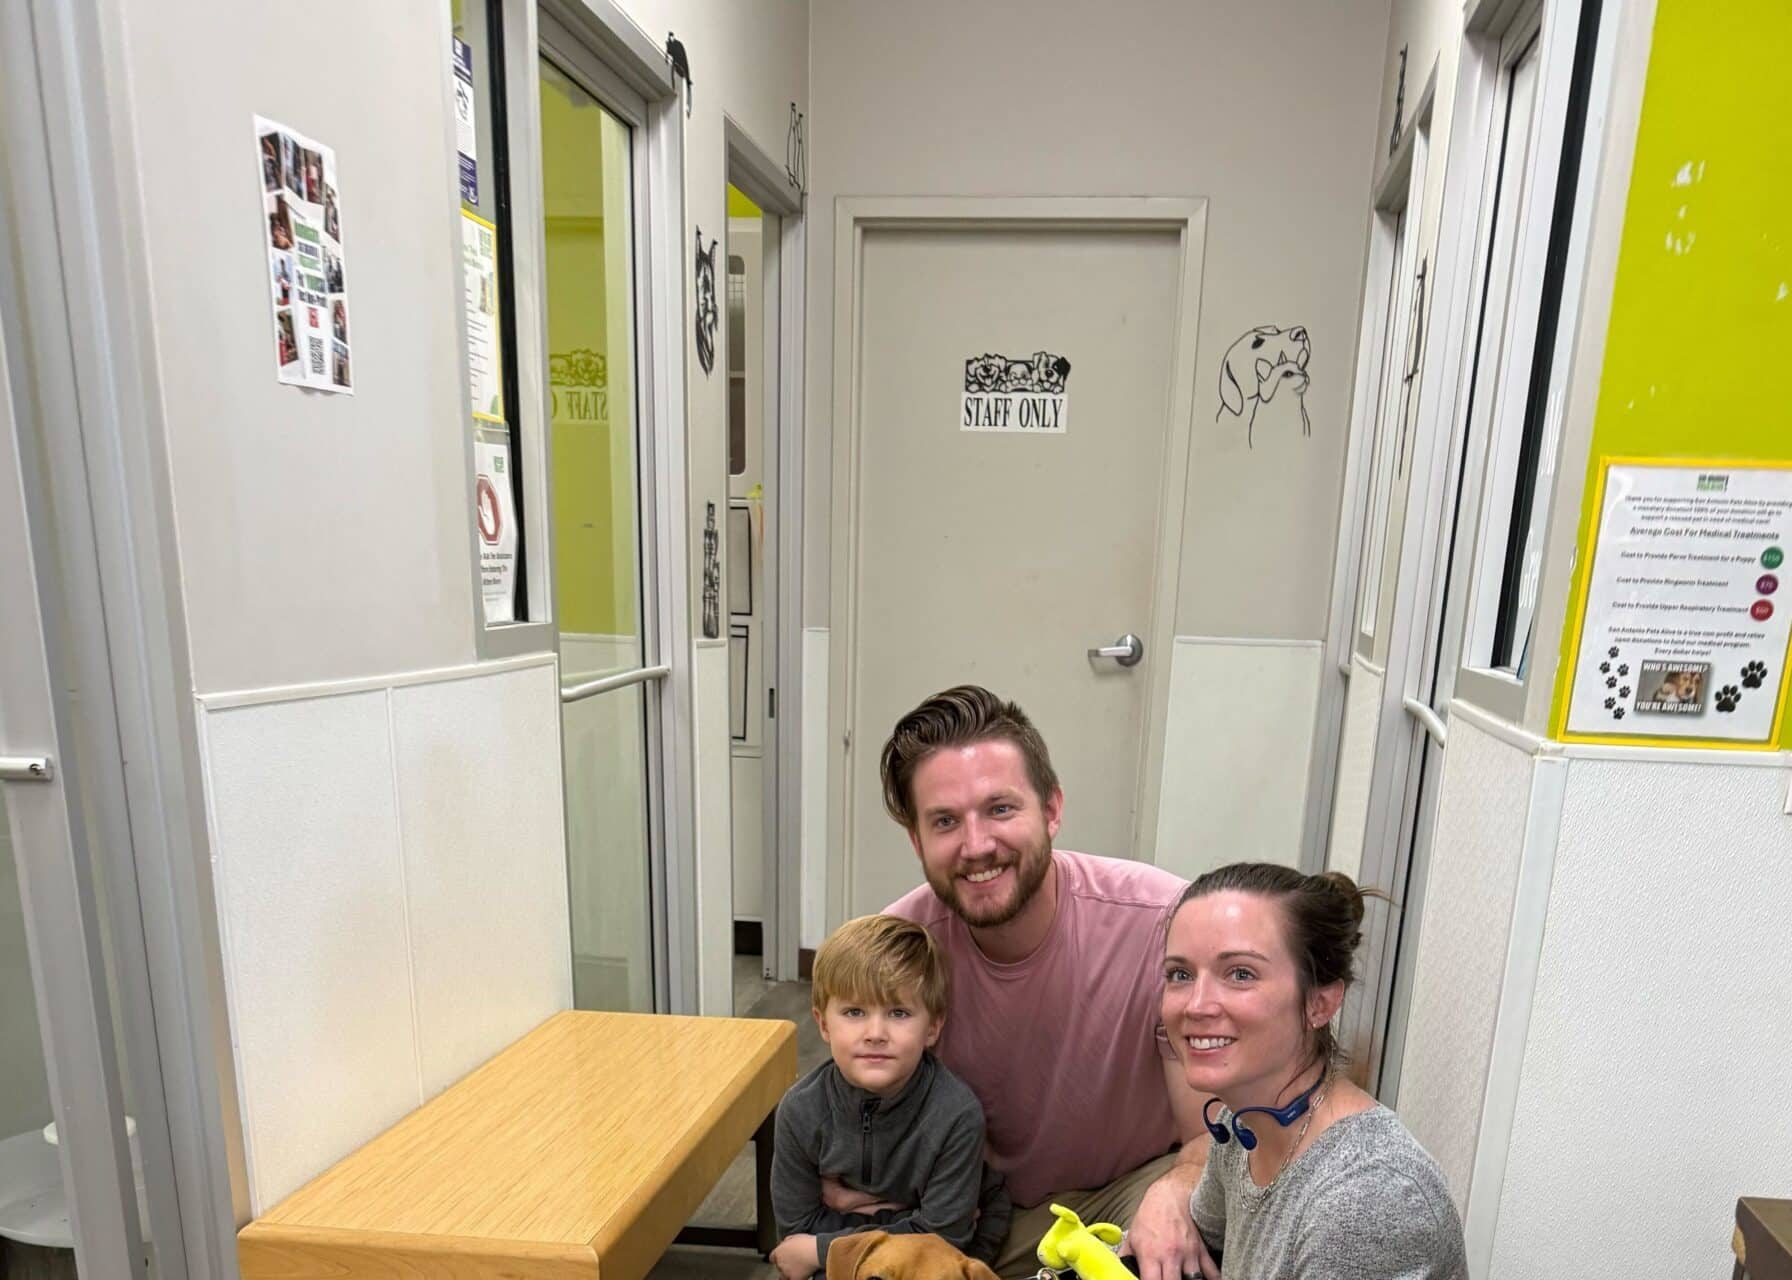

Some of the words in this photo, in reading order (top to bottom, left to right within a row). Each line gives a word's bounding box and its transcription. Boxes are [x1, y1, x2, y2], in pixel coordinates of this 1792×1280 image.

[964, 397, 1012, 427] STAFF
[1019, 398, 1063, 428] ONLY
[1630, 527, 1662, 537] Average
[1663, 527, 1682, 536] Cost
[1684, 528, 1698, 537] For
[1699, 529, 1731, 538] Medical
[1733, 530, 1780, 539] Treatments
[1644, 552, 1668, 560] Provide
[1621, 626, 1645, 634] Antonio
[1655, 648, 1672, 656] Every
[1643, 662, 1667, 672] WHO'S
[1667, 663, 1709, 673] AWESOME?
[1636, 701, 1661, 711] YOU'RE
[1661, 702, 1703, 713] AWESOME!
